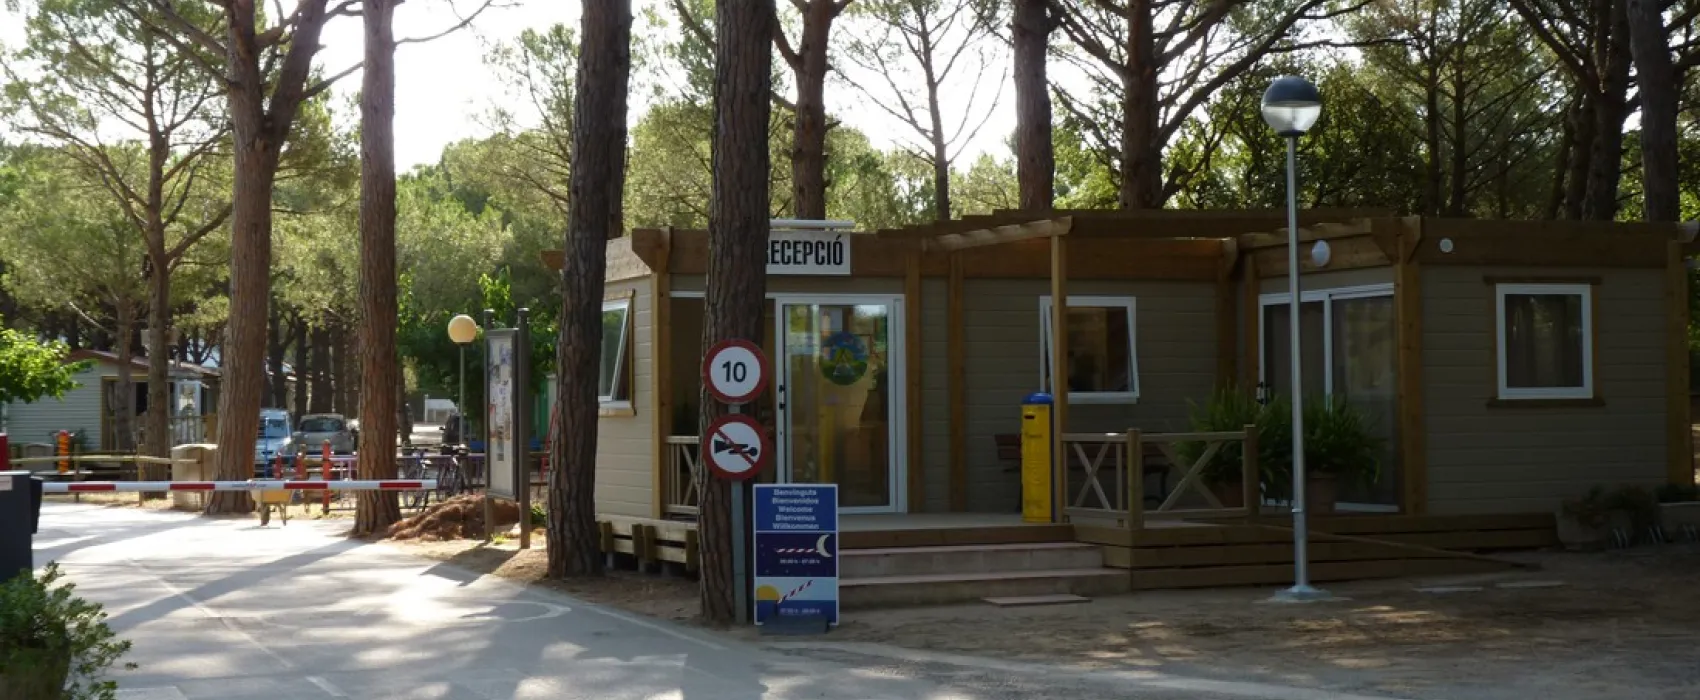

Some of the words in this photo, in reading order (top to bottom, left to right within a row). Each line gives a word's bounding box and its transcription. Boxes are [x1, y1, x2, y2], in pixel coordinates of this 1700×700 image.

[766, 234, 843, 265] ECEPCIÓ
[722, 361, 747, 382] 10
[773, 489, 817, 497] Benvinguts
